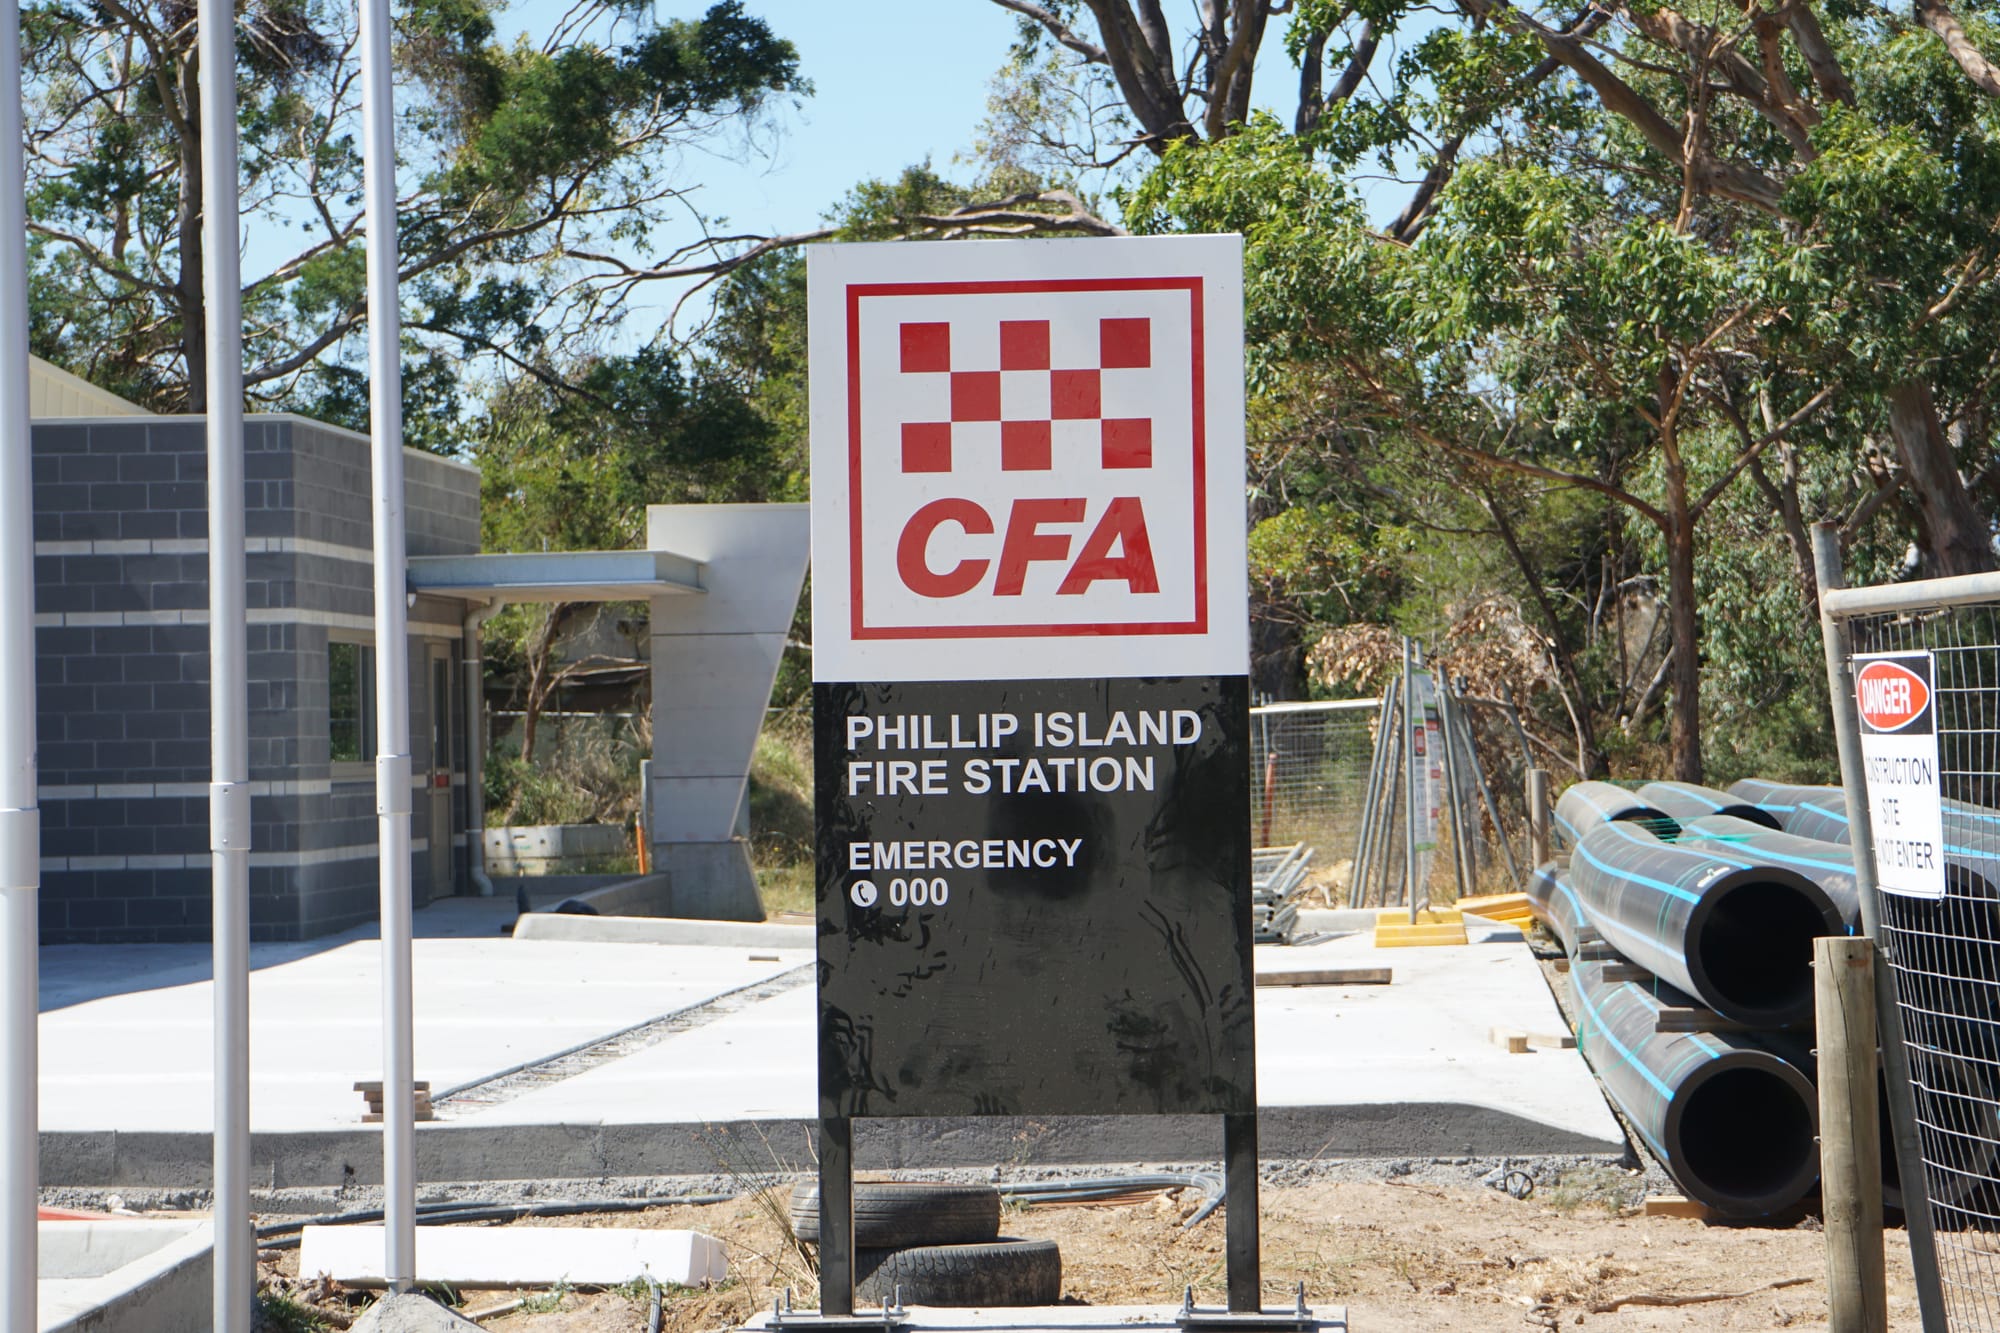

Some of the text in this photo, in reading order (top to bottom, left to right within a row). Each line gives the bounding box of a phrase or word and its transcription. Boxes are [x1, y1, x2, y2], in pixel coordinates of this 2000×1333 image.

[897, 497, 1160, 598] CFA
[1861, 677, 1912, 714] DANGER
[847, 710, 1201, 750] PHILLIP ISLAND
[848, 756, 1154, 796] FIRE STATION
[849, 838, 1083, 871] EMERGENCY
[1896, 840, 1934, 870] ENTER
[889, 878, 949, 907] 000
